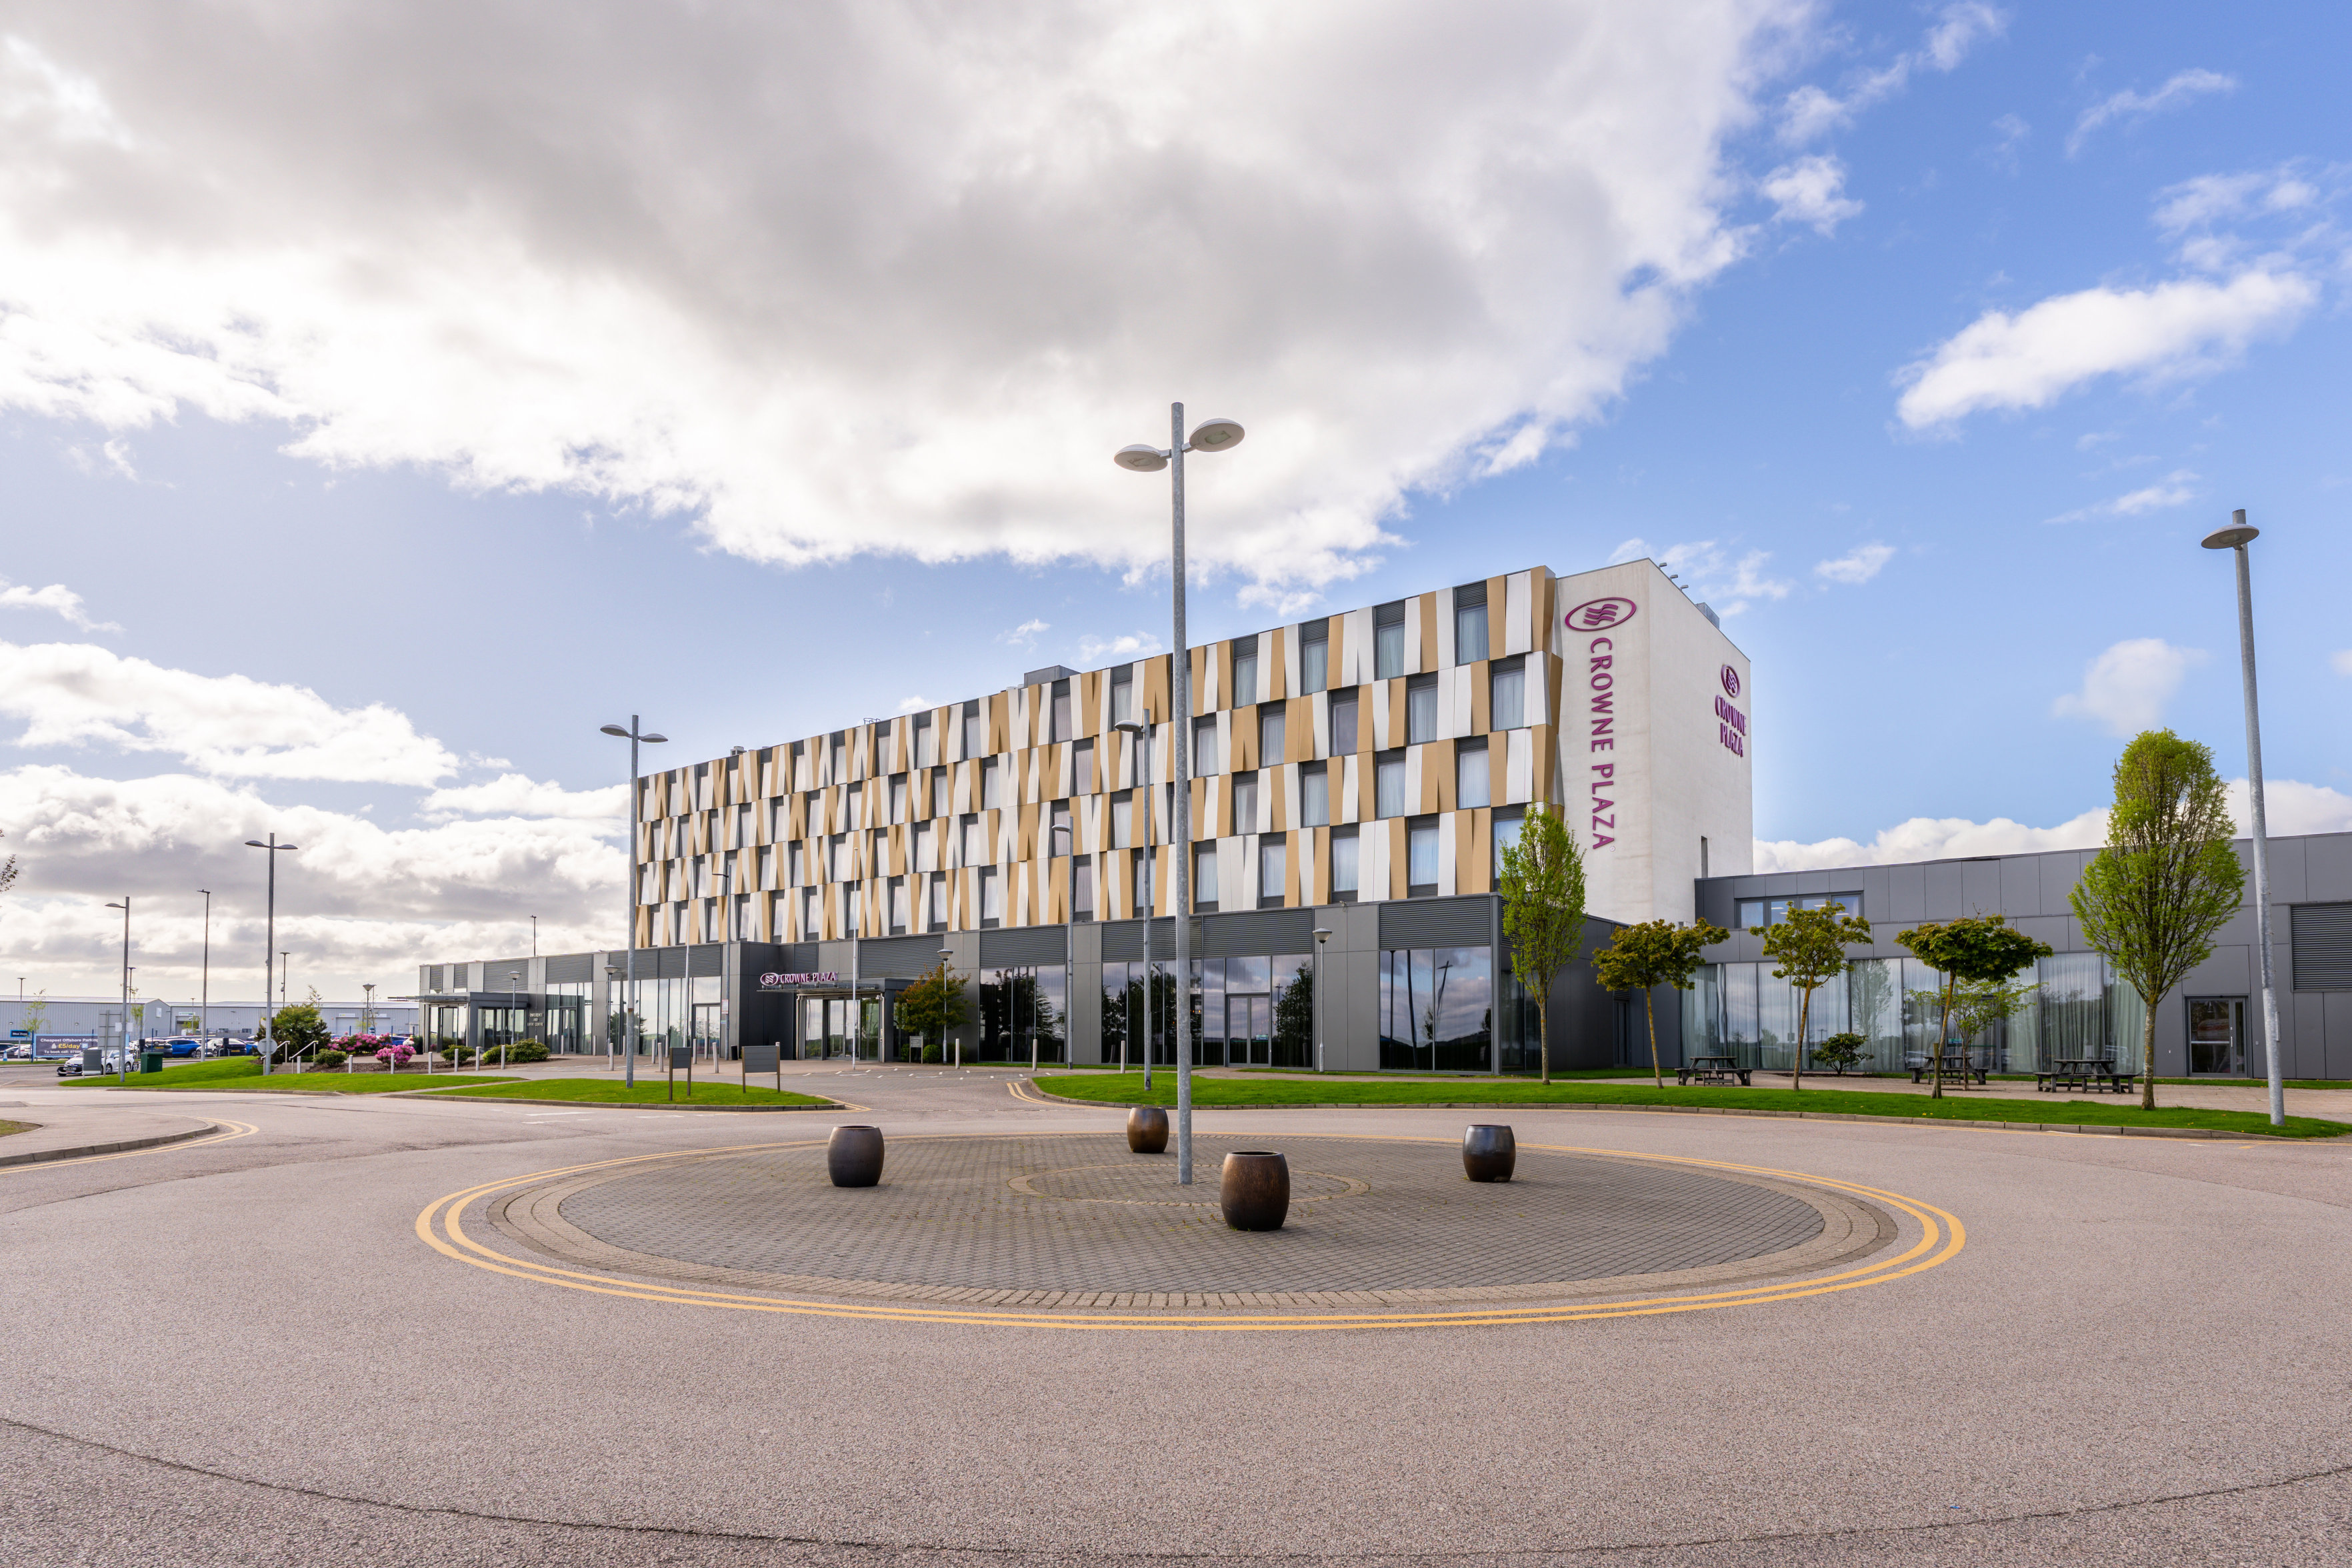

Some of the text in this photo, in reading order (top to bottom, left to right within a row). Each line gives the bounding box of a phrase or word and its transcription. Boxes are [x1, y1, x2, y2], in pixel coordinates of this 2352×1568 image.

[1715, 695, 1747, 736] CROWNE
[1590, 637, 1615, 849] CROWNE PLAZA
[1720, 722, 1743, 757] PLAZA
[780, 971, 837, 983] CROWNE PLAZA
